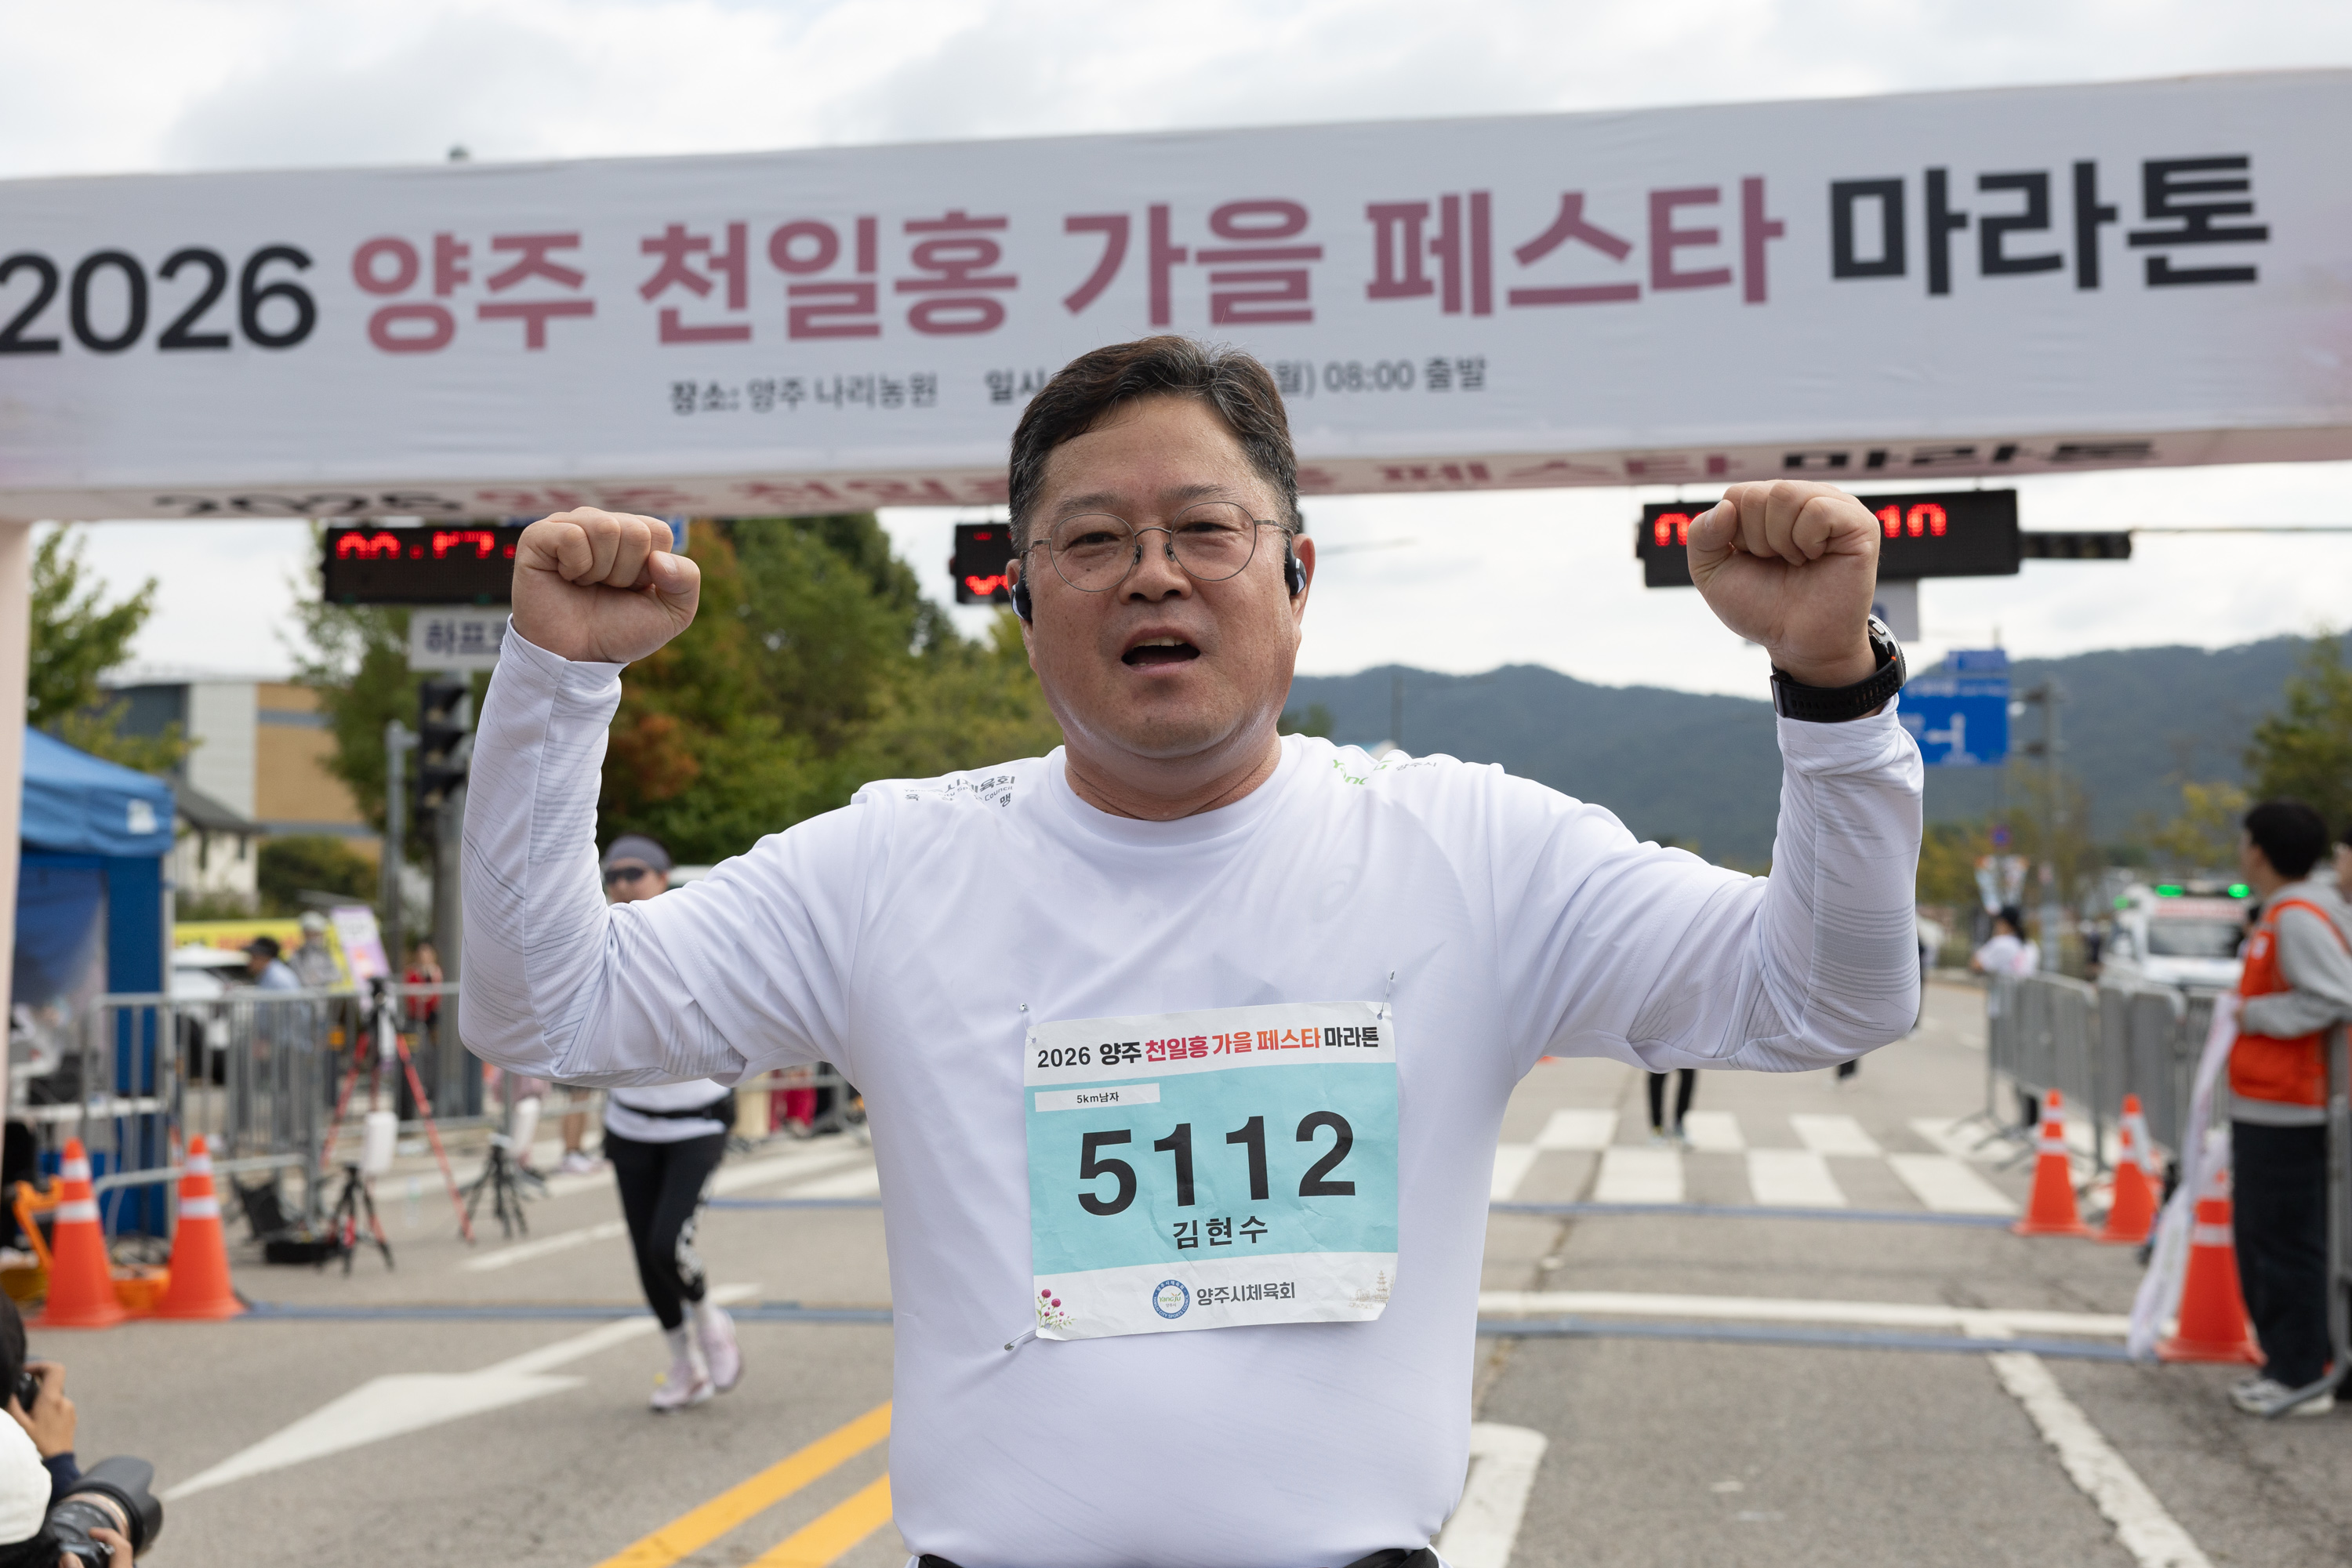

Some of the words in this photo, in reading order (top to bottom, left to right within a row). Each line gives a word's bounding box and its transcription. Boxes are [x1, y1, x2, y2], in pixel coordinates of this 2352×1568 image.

[0, 245, 317, 355] 2026
[352, 232, 595, 354] 양주
[639, 210, 1018, 344] 천일홍
[1063, 198, 1323, 326] 가을
[1366, 176, 1785, 317] 페스타
[1830, 154, 2270, 296] 마라톤
[670, 380, 739, 416] 장소:
[747, 376, 807, 413] 양주
[815, 372, 938, 409] 나리농원
[1323, 359, 1416, 393] 08:00
[1425, 357, 1486, 391] 출발
[1037, 1046, 1091, 1069] 2026
[1099, 1041, 1142, 1065] 양주
[1145, 1035, 1209, 1062] 천일홍
[1211, 1031, 1253, 1055] 가을
[1256, 1027, 1321, 1051] 페스타
[1323, 1026, 1379, 1048] 마라톤
[1076, 1091, 1120, 1104] 5km남자
[1077, 1110, 1356, 1217] 5112
[1173, 1215, 1269, 1250] 김현수
[1196, 1281, 1295, 1306] 양주시체육회
